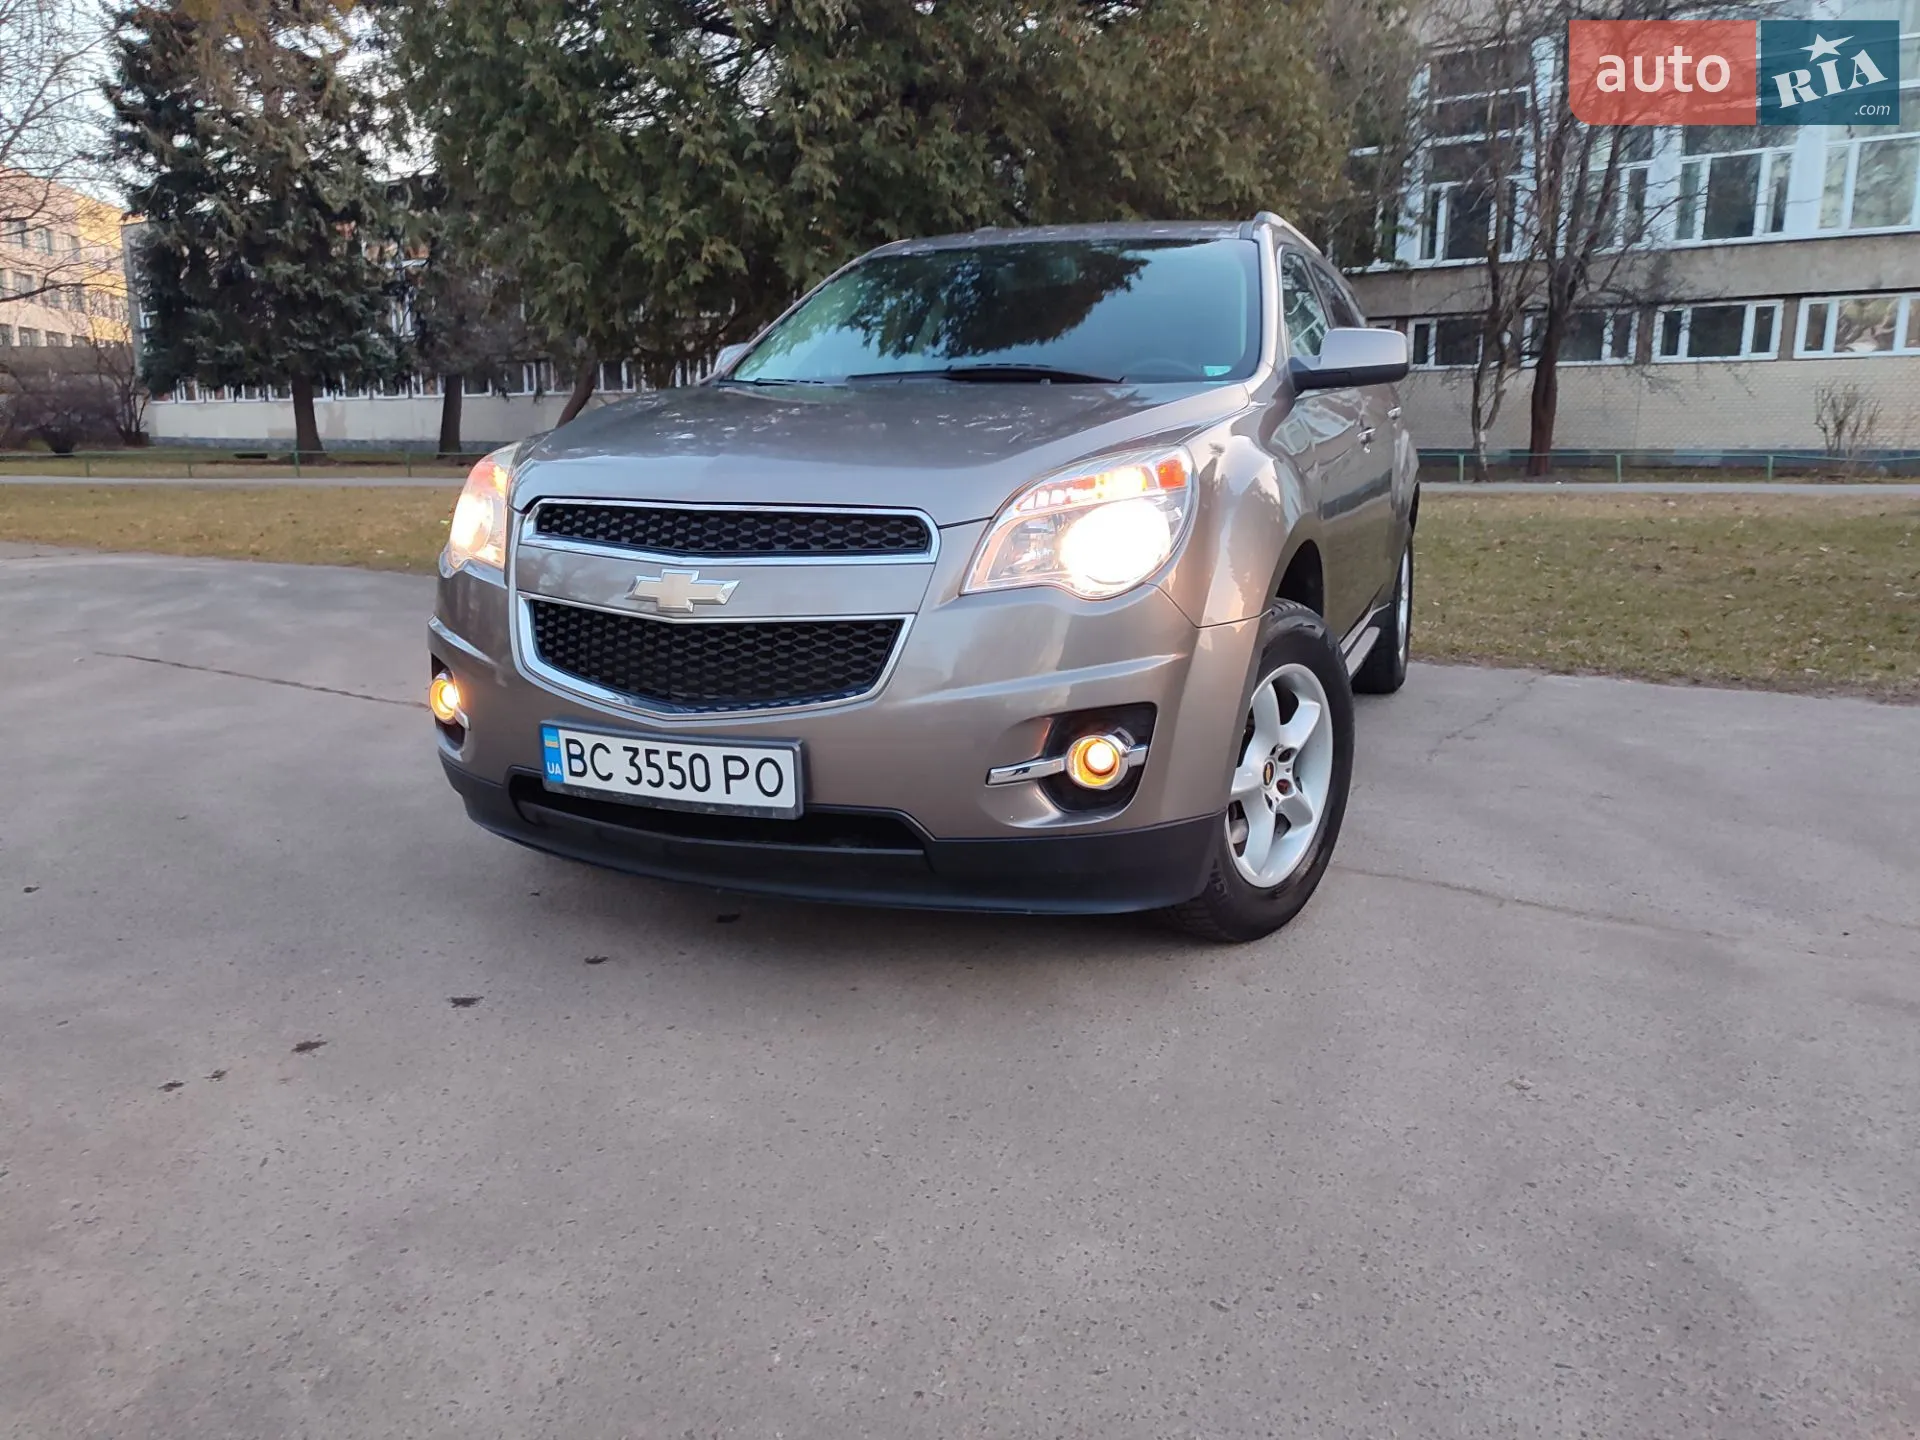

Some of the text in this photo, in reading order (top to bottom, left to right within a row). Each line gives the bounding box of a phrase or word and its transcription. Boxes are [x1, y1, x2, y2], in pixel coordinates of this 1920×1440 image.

[547, 761, 563, 776] UA
[565, 738, 784, 797] BC 3550 PO
